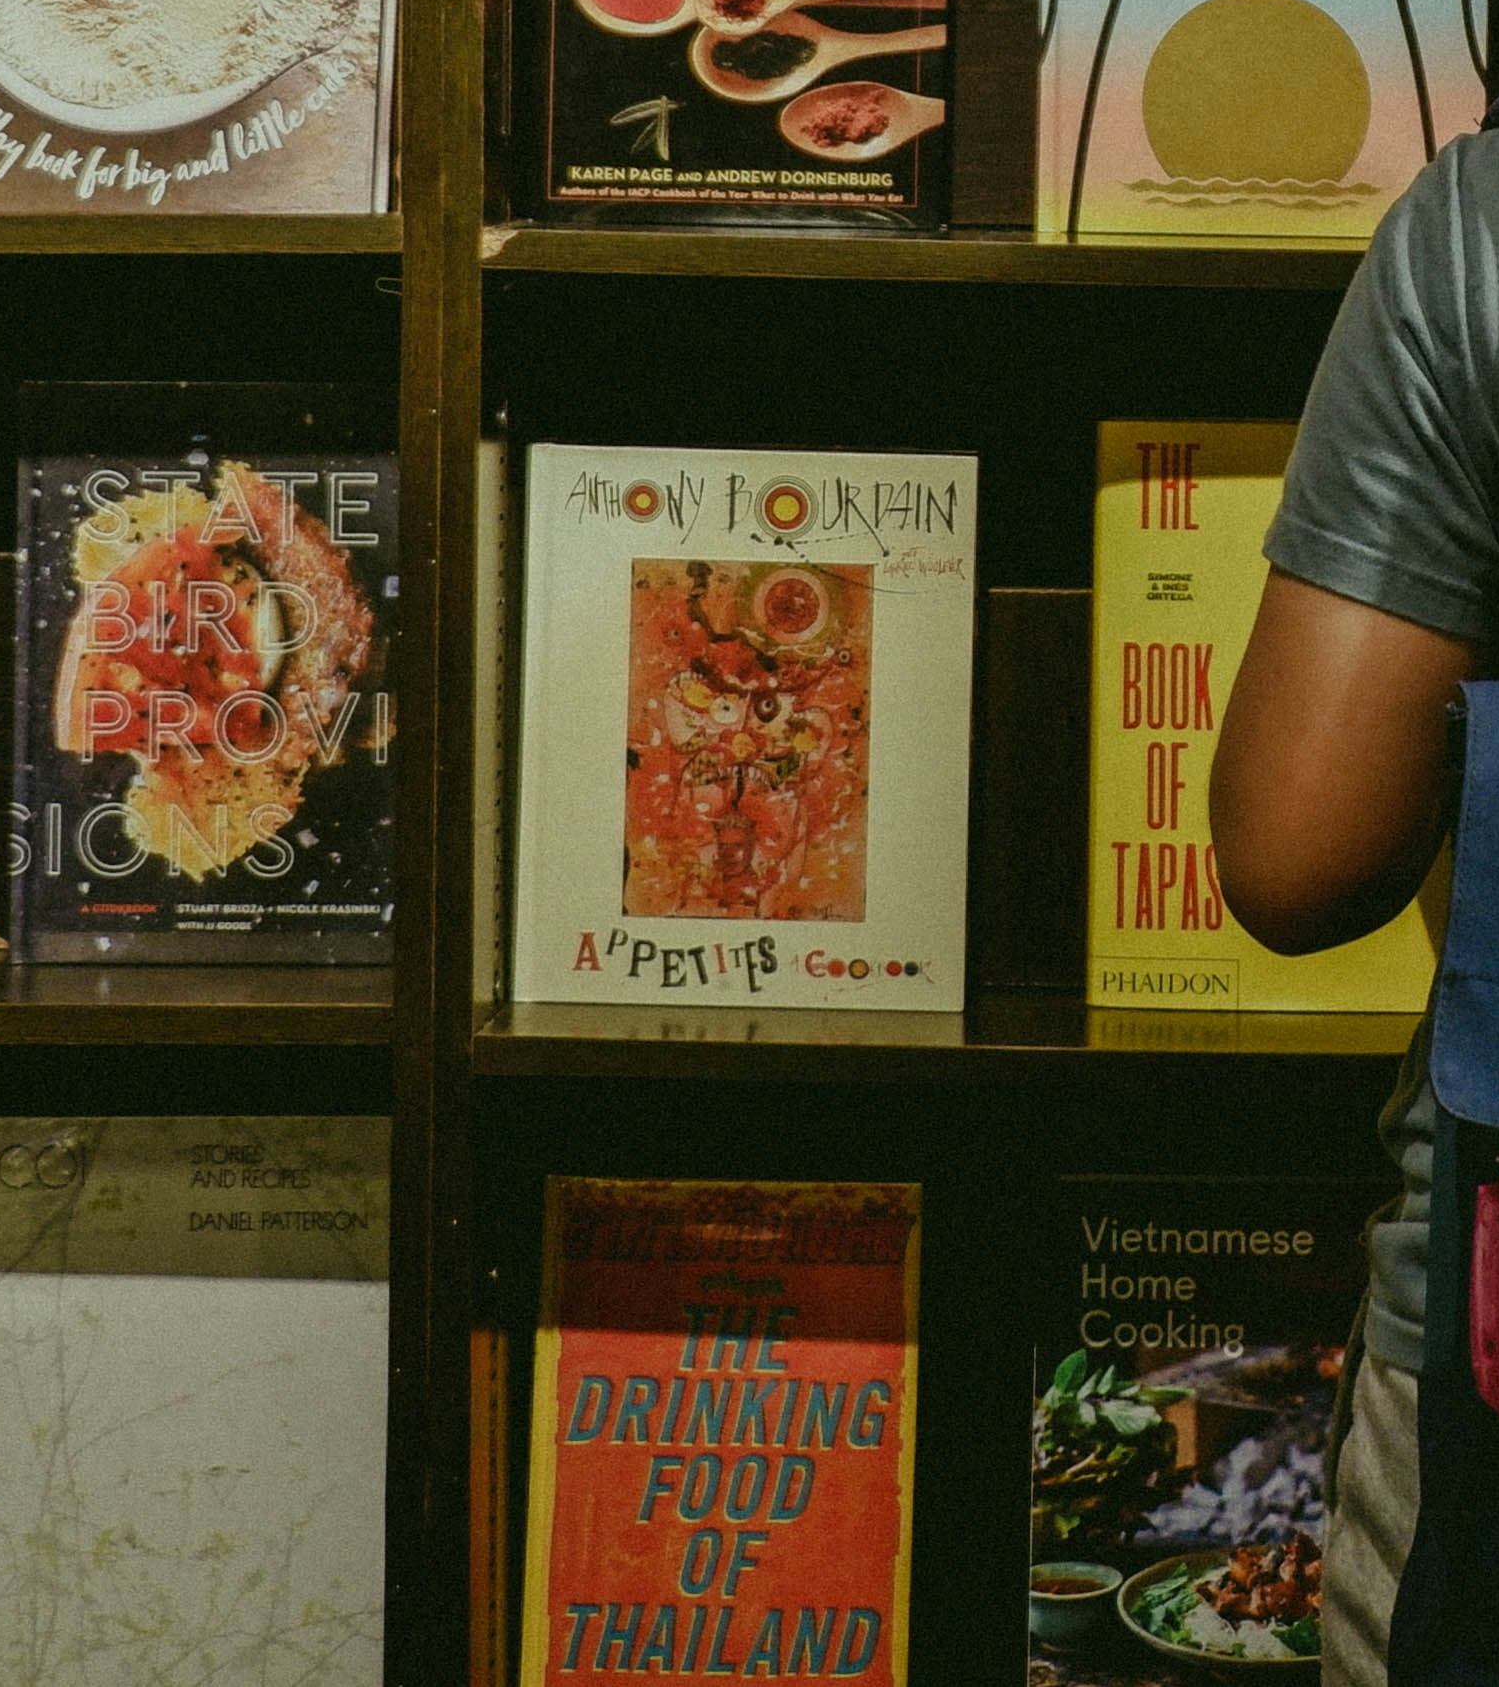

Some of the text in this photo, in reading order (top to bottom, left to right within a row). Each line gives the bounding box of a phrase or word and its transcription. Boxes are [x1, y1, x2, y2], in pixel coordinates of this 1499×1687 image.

[571, 164, 894, 187] KAREN PAGE AND ANDREW DORNENBURG
[1136, 442, 1201, 533] THE
[1121, 643, 1214, 733] BOOK
[1146, 742, 1187, 830] OF
[1110, 841, 1224, 932] TAPAS
[1101, 970, 1231, 997] PHAIDON
[1082, 1216, 1314, 1257] Vietnamese
[1082, 1267, 1196, 1302] Home
[1080, 1309, 1244, 1358] Cooking
[564, 1376, 894, 1450] DRINKING
[635, 1454, 817, 1525] FOOD
[676, 1528, 771, 1599] OF
[559, 1601, 881, 1679] THAILAND
